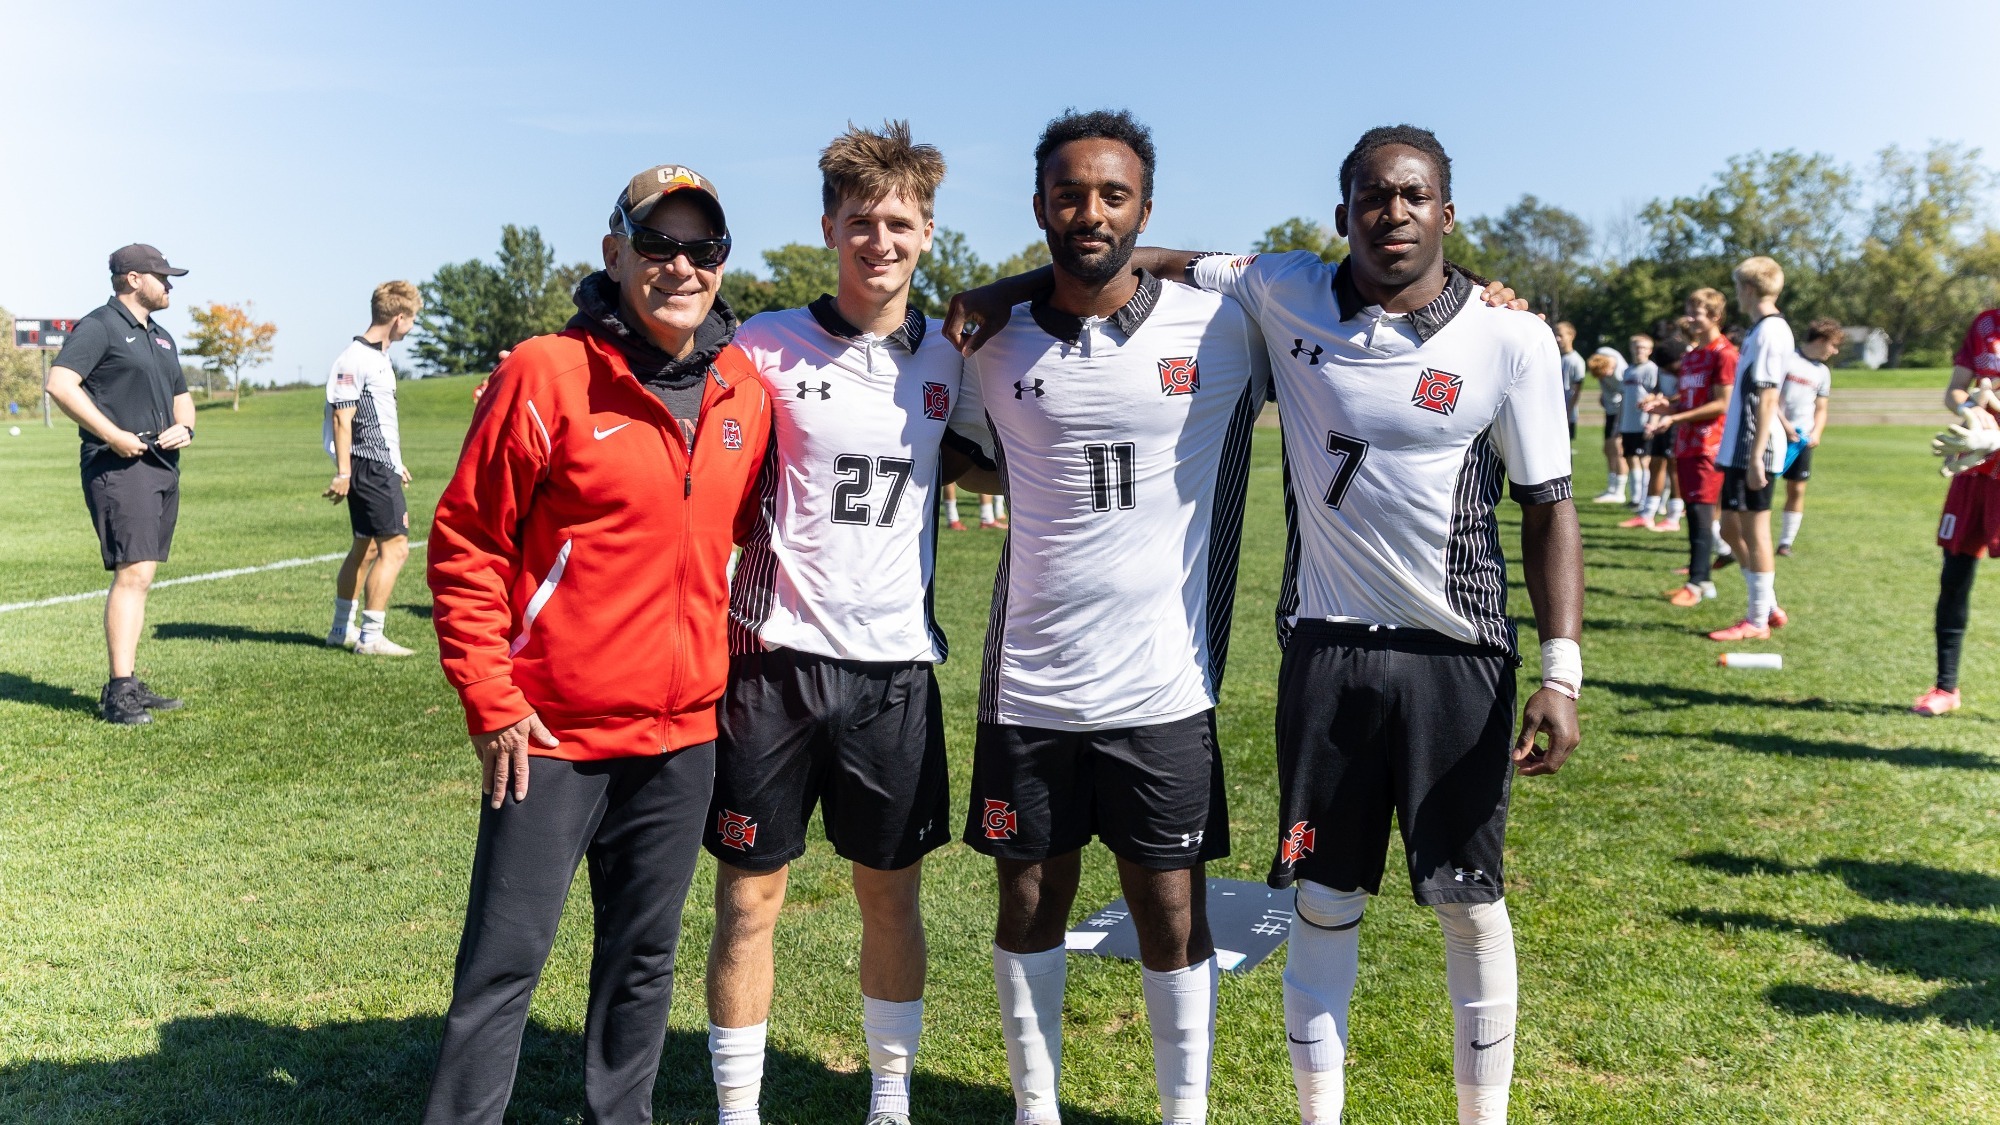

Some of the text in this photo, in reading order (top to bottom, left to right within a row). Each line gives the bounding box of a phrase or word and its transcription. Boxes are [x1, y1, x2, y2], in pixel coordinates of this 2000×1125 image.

[657, 166, 705, 187] CAT
[1171, 367, 1190, 385] G
[931, 392, 945, 412] G
[1427, 382, 1448, 401] G
[1083, 442, 1136, 513] 11
[1323, 430, 1370, 511] 7
[830, 453, 916, 528] 27
[724, 820, 746, 841] G
[986, 808, 1008, 831] G
[1290, 831, 1304, 856] G
